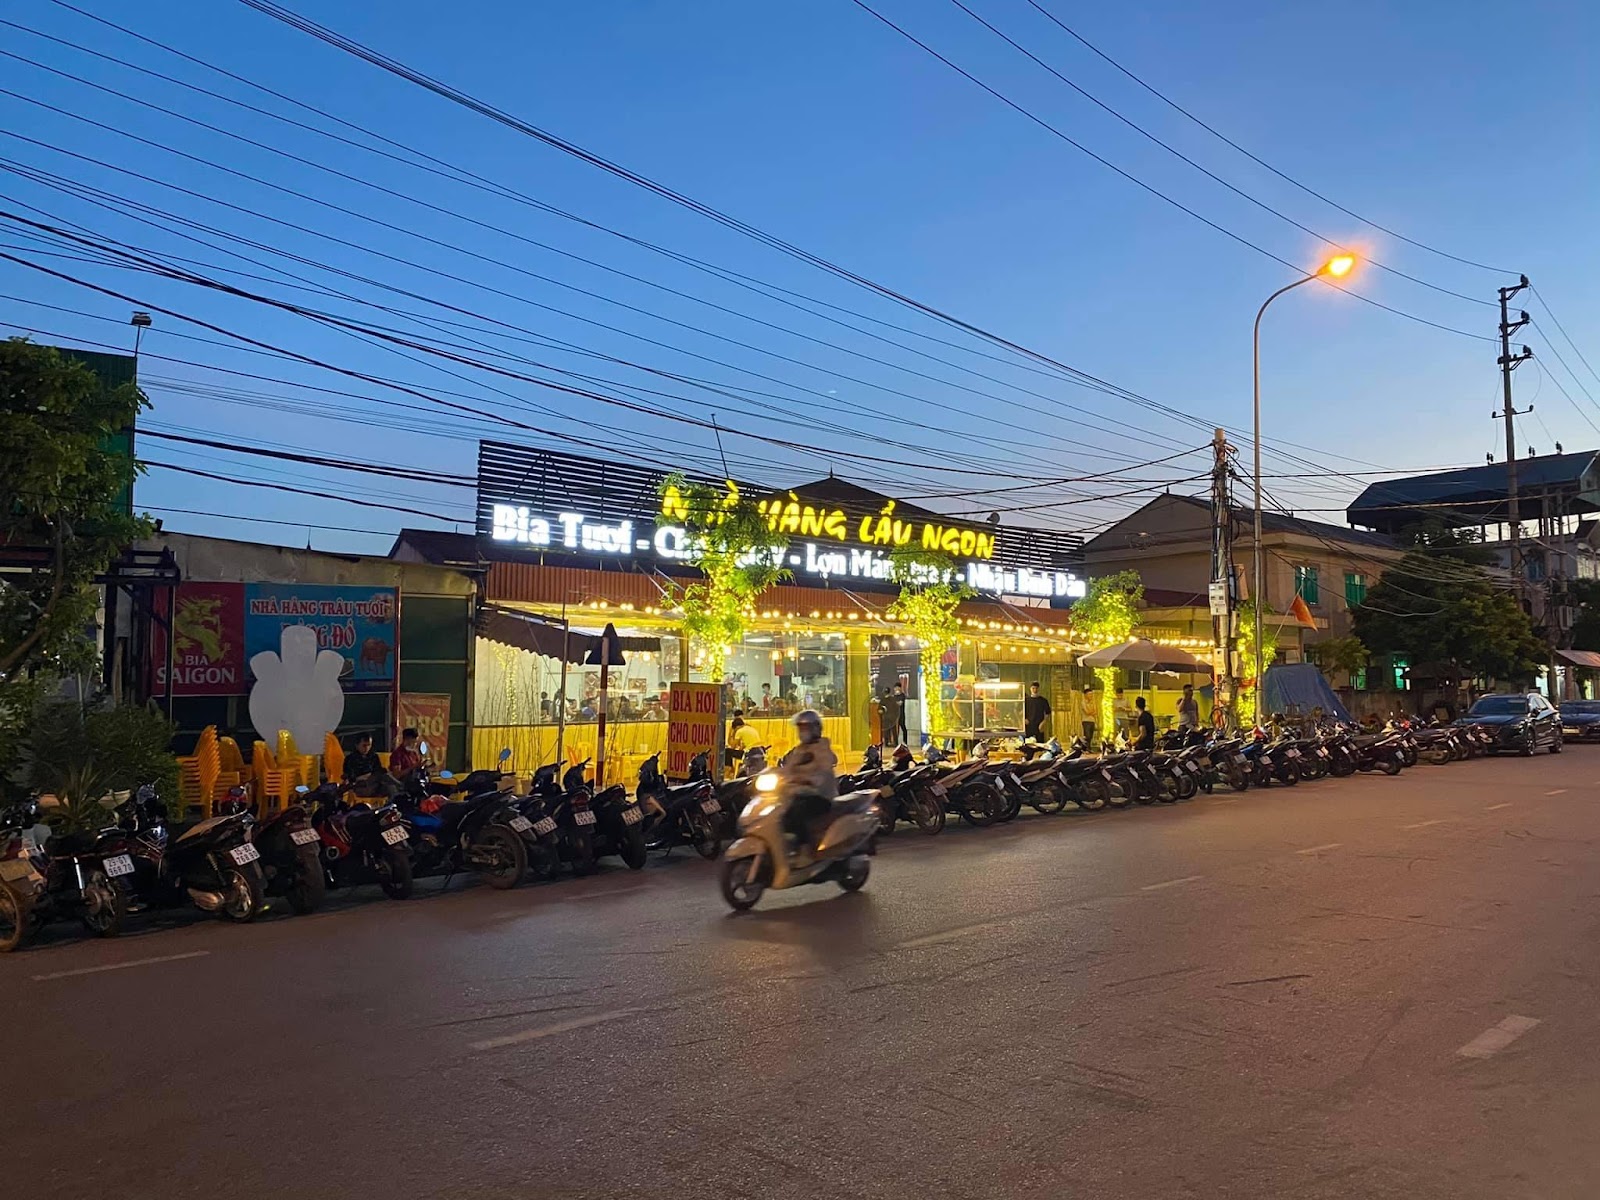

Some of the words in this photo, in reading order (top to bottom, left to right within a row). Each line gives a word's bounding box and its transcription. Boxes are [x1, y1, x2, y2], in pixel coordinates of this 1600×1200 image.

[492, 504, 550, 545] Bia
[1055, 572, 1086, 597] Dân
[922, 523, 995, 560] NGON
[250, 596, 279, 615] NHÀ
[280, 596, 318, 616] HÀNG
[319, 597, 354, 617] TRÂU
[185, 654, 209, 666] BIA
[156, 667, 235, 684] SAIGON
[672, 690, 692, 713] BIA
[670, 719, 688, 743] CHÓ
[691, 724, 716, 746] QUAY
